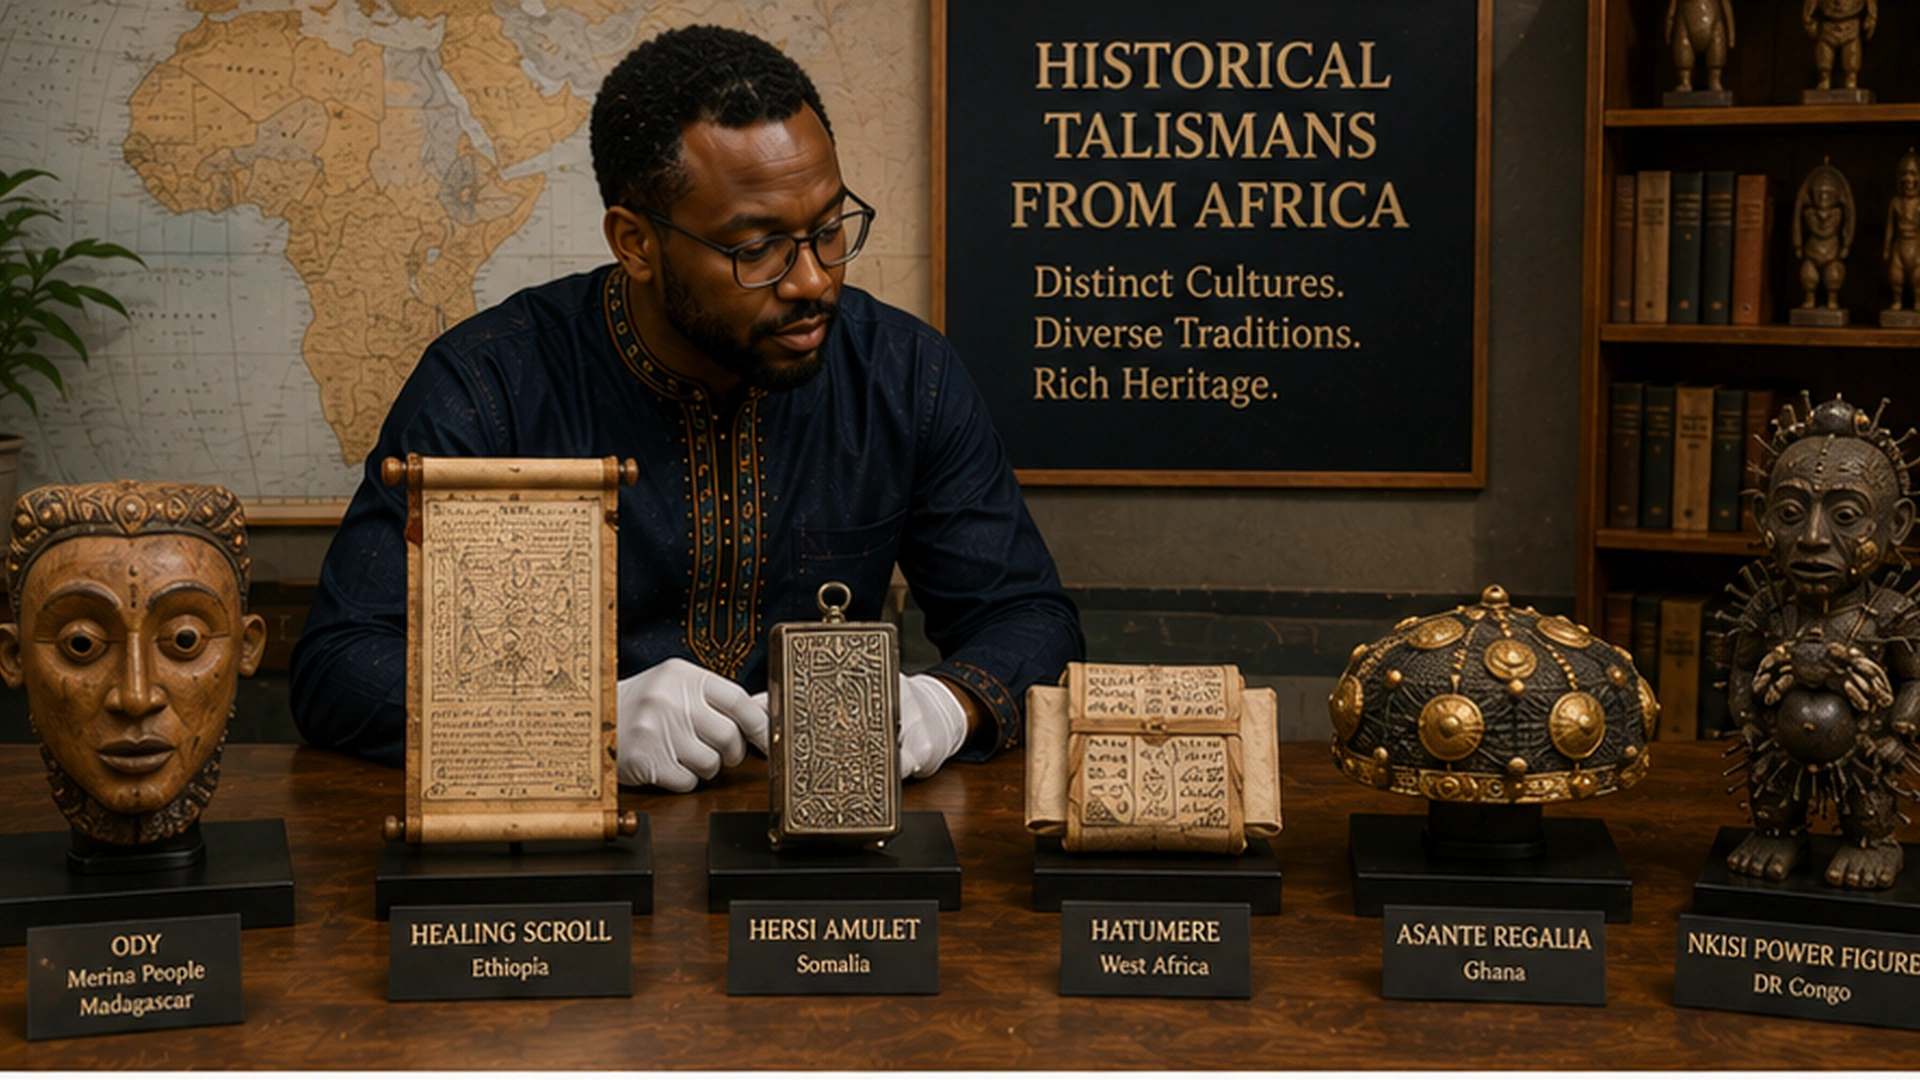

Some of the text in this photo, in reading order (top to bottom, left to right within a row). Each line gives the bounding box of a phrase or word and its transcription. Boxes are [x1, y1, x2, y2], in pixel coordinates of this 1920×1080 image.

[1035, 41, 1392, 90] HISTORICAL
[1043, 111, 1377, 159] TALISMANS
[1011, 180, 1409, 229] FROM AFRICA
[1034, 264, 1344, 299] Distinct Cultures.
[1034, 315, 1361, 349] Diverse Traditions.
[1034, 365, 1278, 409] Rich Heritage.
[411, 919, 612, 946] HEALING SCROLL
[749, 918, 921, 941] HERSI AMULET
[1091, 919, 1221, 943] HATUMERE
[1396, 923, 1592, 950] ASANTE REGALIA
[111, 933, 162, 957] ODY
[1688, 932, 1920, 976] NKISI POWER FIGURE
[67, 959, 206, 989] Merina People
[472, 955, 550, 981] Ethiopia
[796, 953, 871, 974] Somalia
[1100, 954, 1210, 976] West Africa
[1463, 960, 1526, 982] Ghana
[1753, 973, 1852, 1005] DR Congo
[79, 992, 194, 1018] Madagascar
